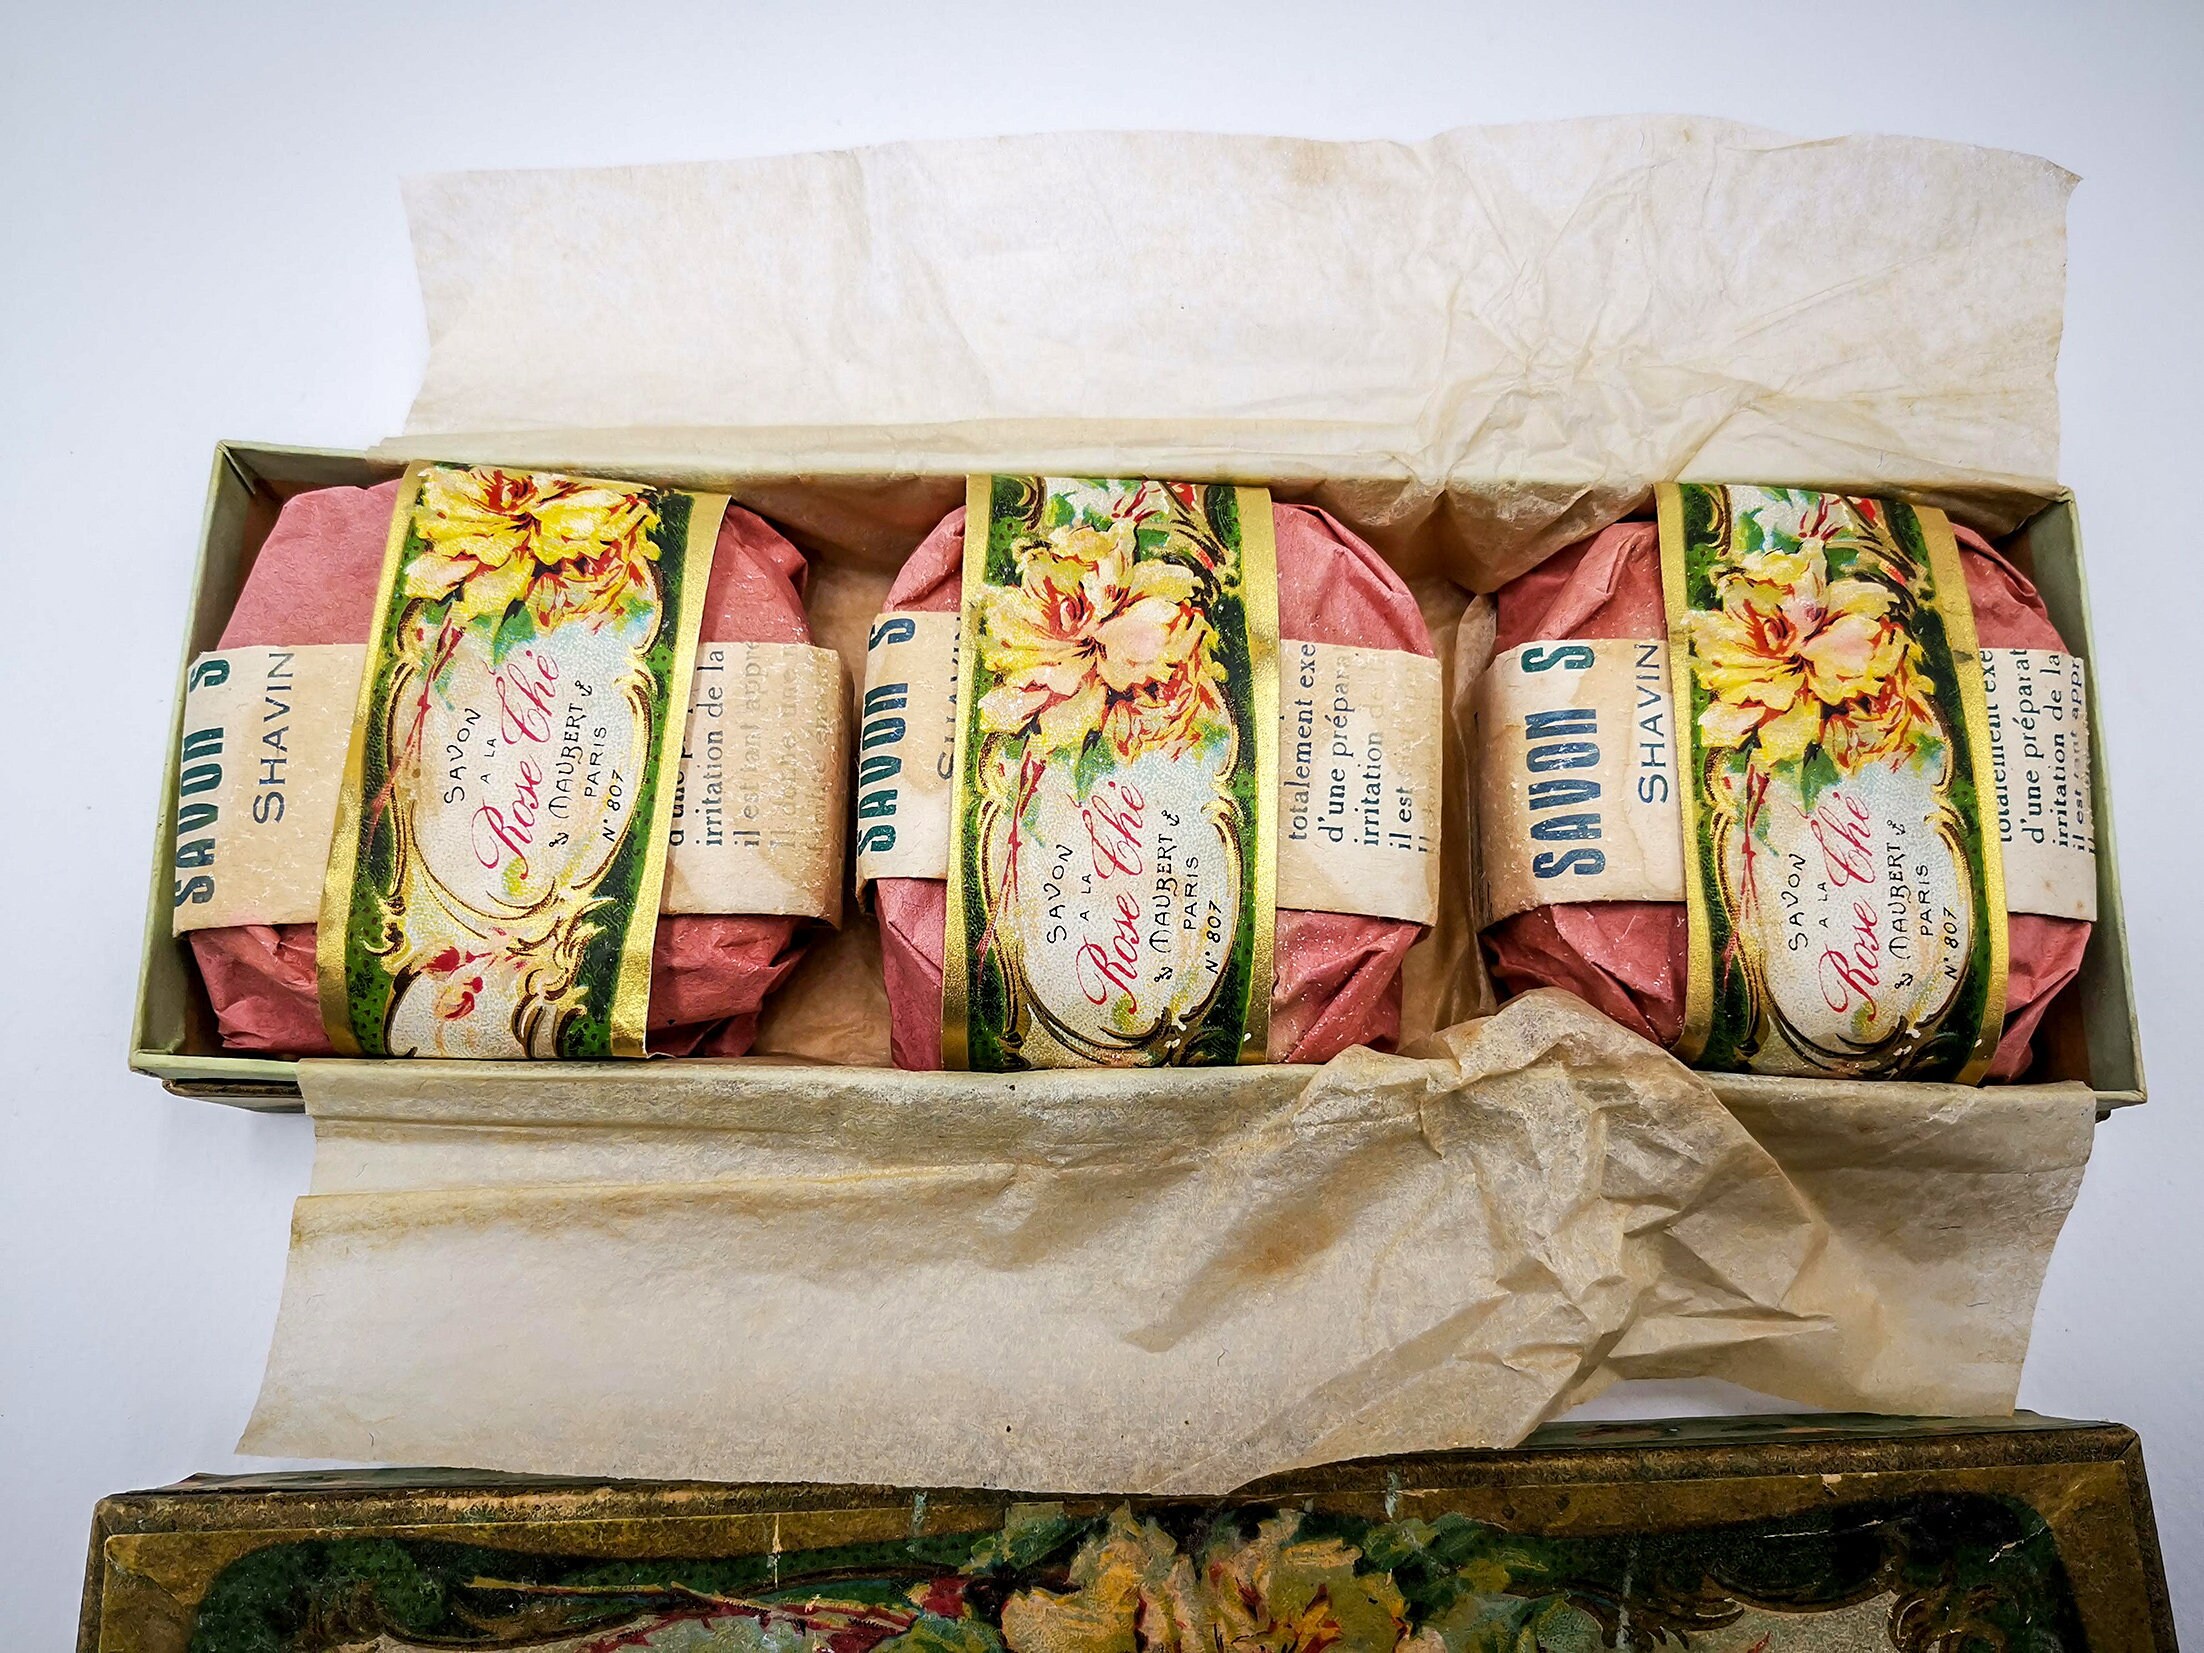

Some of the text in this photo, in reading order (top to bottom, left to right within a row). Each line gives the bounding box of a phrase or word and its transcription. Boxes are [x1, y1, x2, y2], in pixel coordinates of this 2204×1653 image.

[253, 653, 295, 824] SHAVIN
[444, 708, 481, 804] SAVON
[484, 738, 497, 758] LA
[584, 727, 607, 797] PARIS
[695, 650, 724, 846] irritation de la
[858, 617, 916, 856] SAVON S
[1283, 644, 1316, 841] totalement exe
[1521, 645, 1606, 879] SAVON S
[1634, 643, 1669, 804] SHAVIN
[2009, 648, 2045, 844] d'une préparat
[2040, 655, 2069, 847] irritation de la
[174, 727, 225, 907] SAVON
[471, 754, 543, 880] Rose
[607, 769, 625, 811] 807
[1317, 768, 1346, 843] d'une
[1353, 732, 1384, 846] irritation
[1394, 786, 1413, 824] est
[2073, 788, 2084, 824] est
[733, 830, 760, 847] il
[1081, 874, 1092, 894] LA
[1388, 832, 1412, 850] il
[2072, 835, 2085, 851] il
[1043, 844, 1073, 944] SAVON
[1184, 856, 1199, 930] PARIS
[1205, 900, 1222, 943] 807
[1781, 853, 1808, 951] SAVON
[1817, 881, 1828, 902] LA
[1916, 864, 1934, 936] PARIS
[1943, 906, 1959, 949] 807
[1076, 891, 1140, 1015] Rose
[1818, 896, 1880, 1022] Rose
